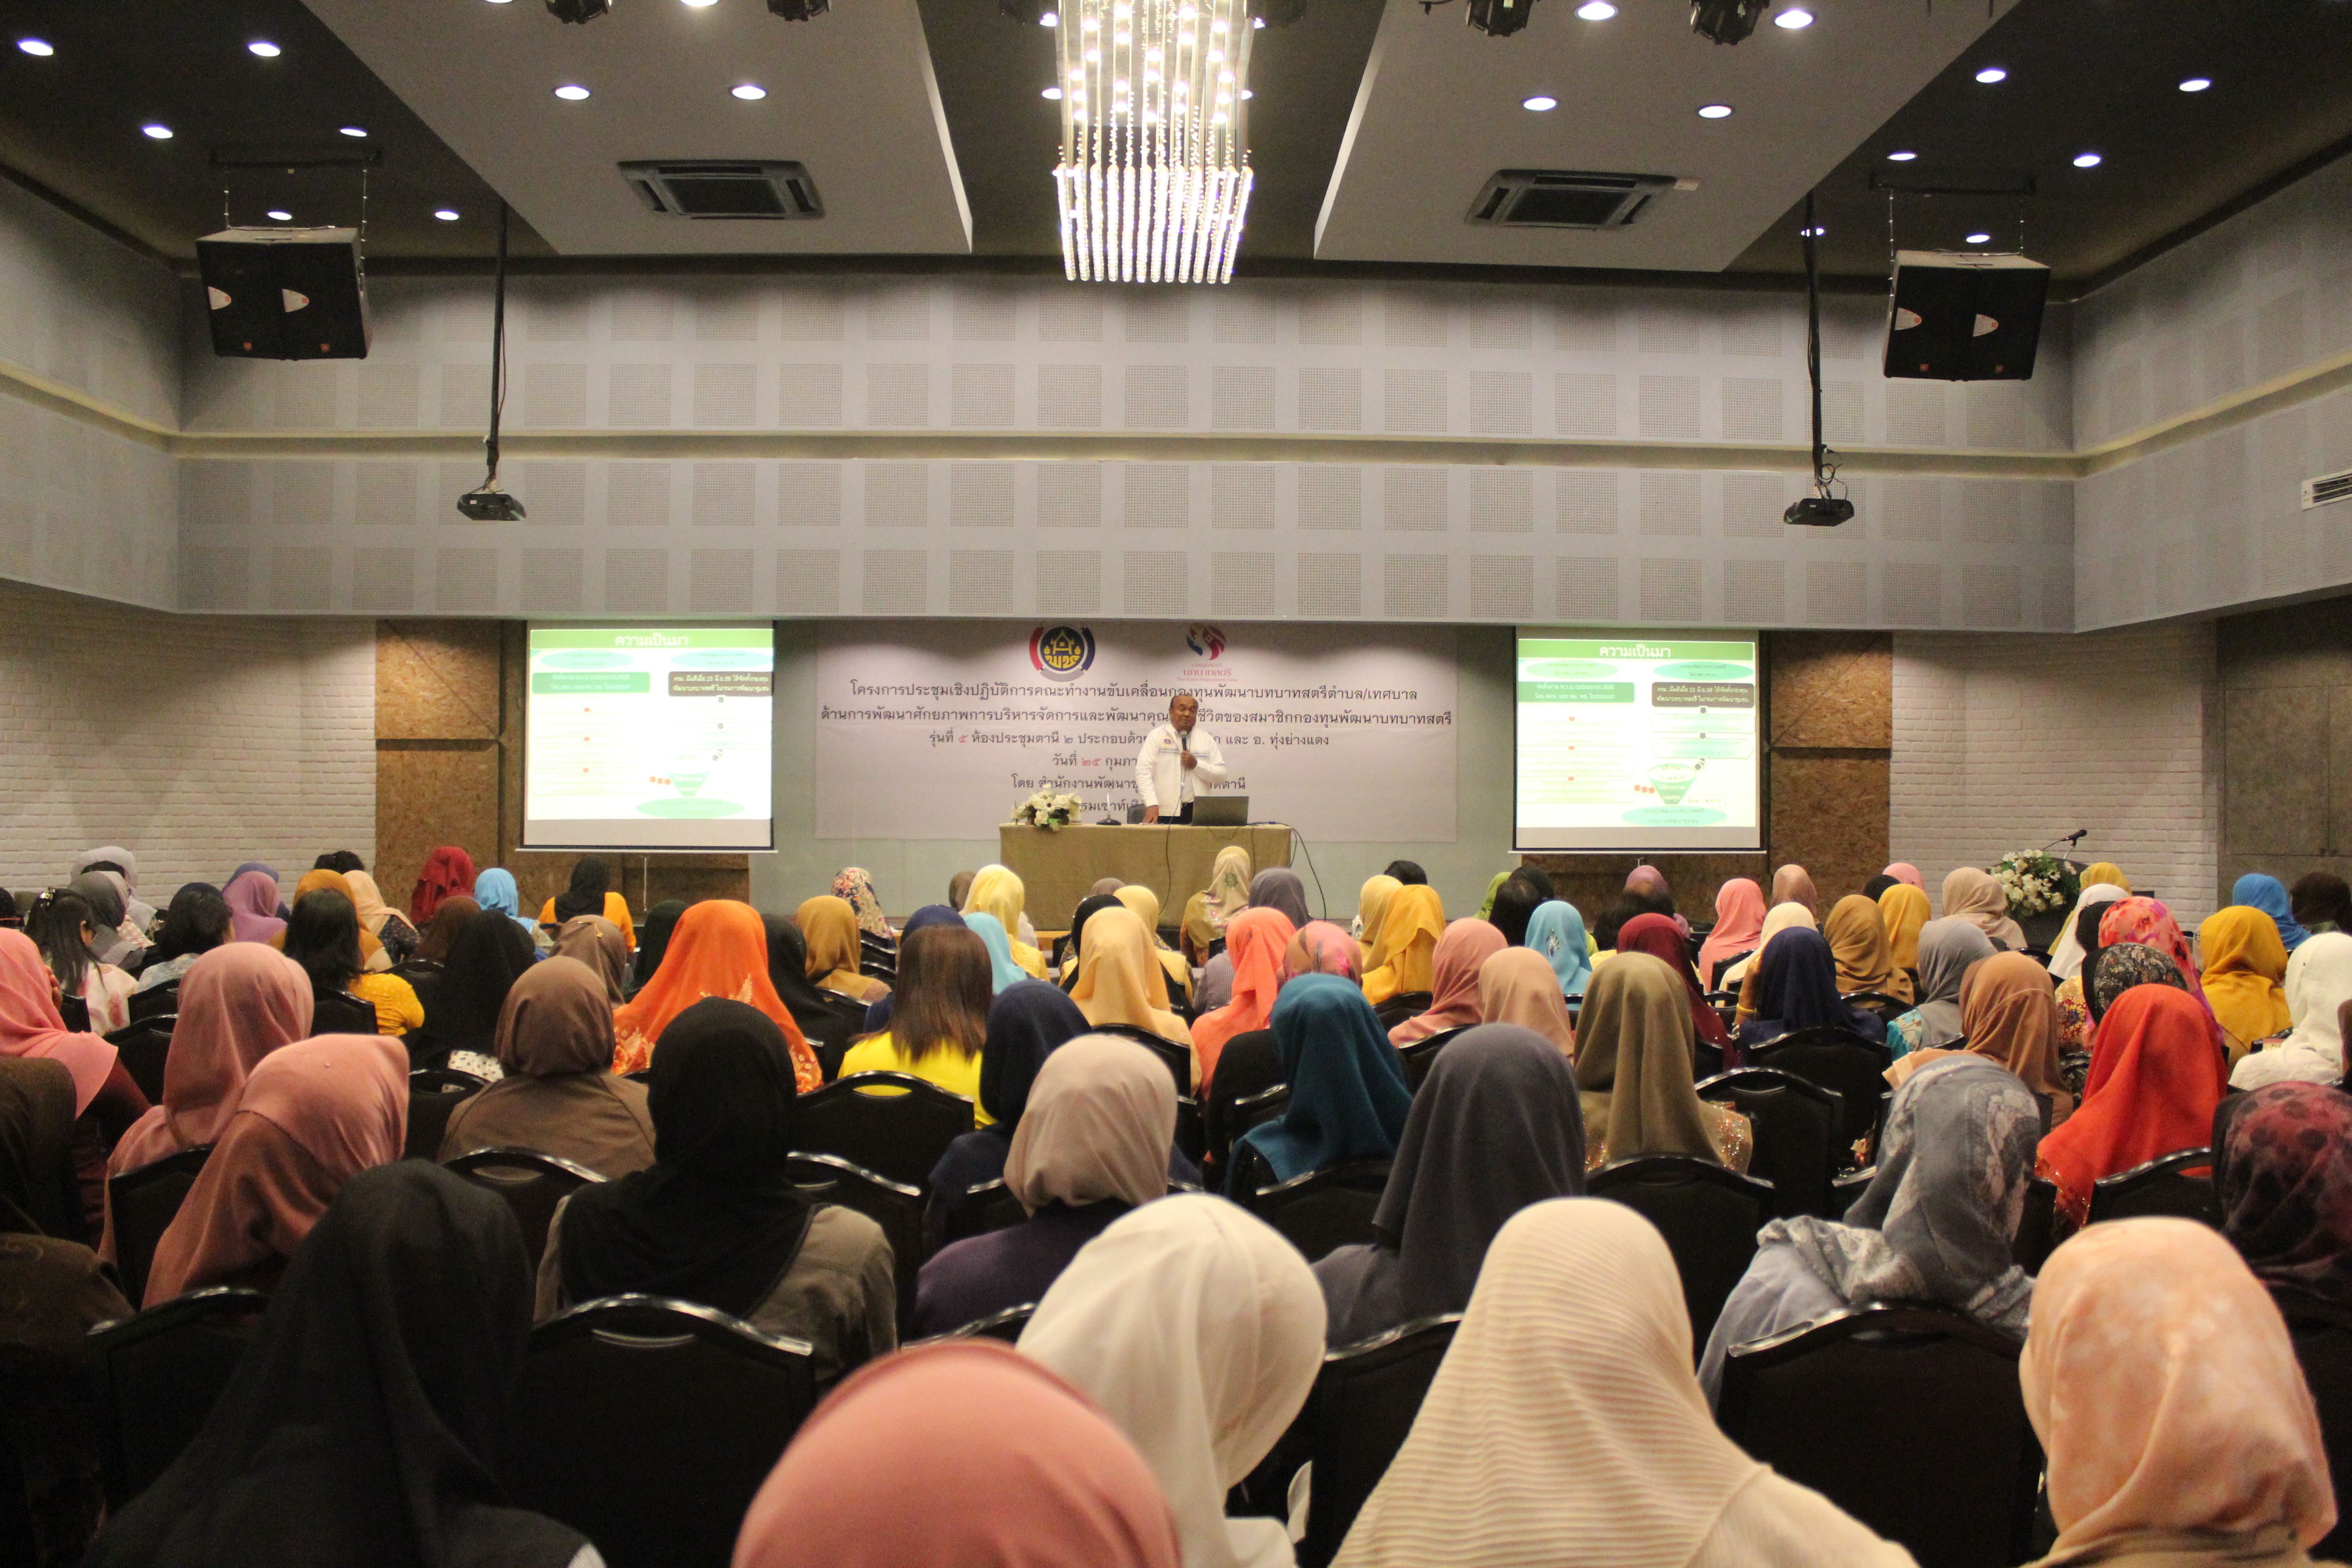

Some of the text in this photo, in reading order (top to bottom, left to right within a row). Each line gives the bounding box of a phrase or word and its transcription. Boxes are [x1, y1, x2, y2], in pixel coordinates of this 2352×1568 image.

[615, 632, 688, 646] ความเป็นมา
[1599, 643, 1671, 658] ความเป็นมา
[1183, 668, 1232, 676] บทบาทสตรี
[930, 727, 953, 748] รุ่นที่
[971, 730, 1059, 748] ห้องประชุมตานี
[1064, 735, 1073, 744] ๒
[1226, 736, 1248, 745] และ
[1270, 733, 1329, 750] ทุ่งย่างแดง
[1053, 750, 1137, 771] วันที่ ๒๕ กุมภา
[1011, 773, 1034, 789] โดย
